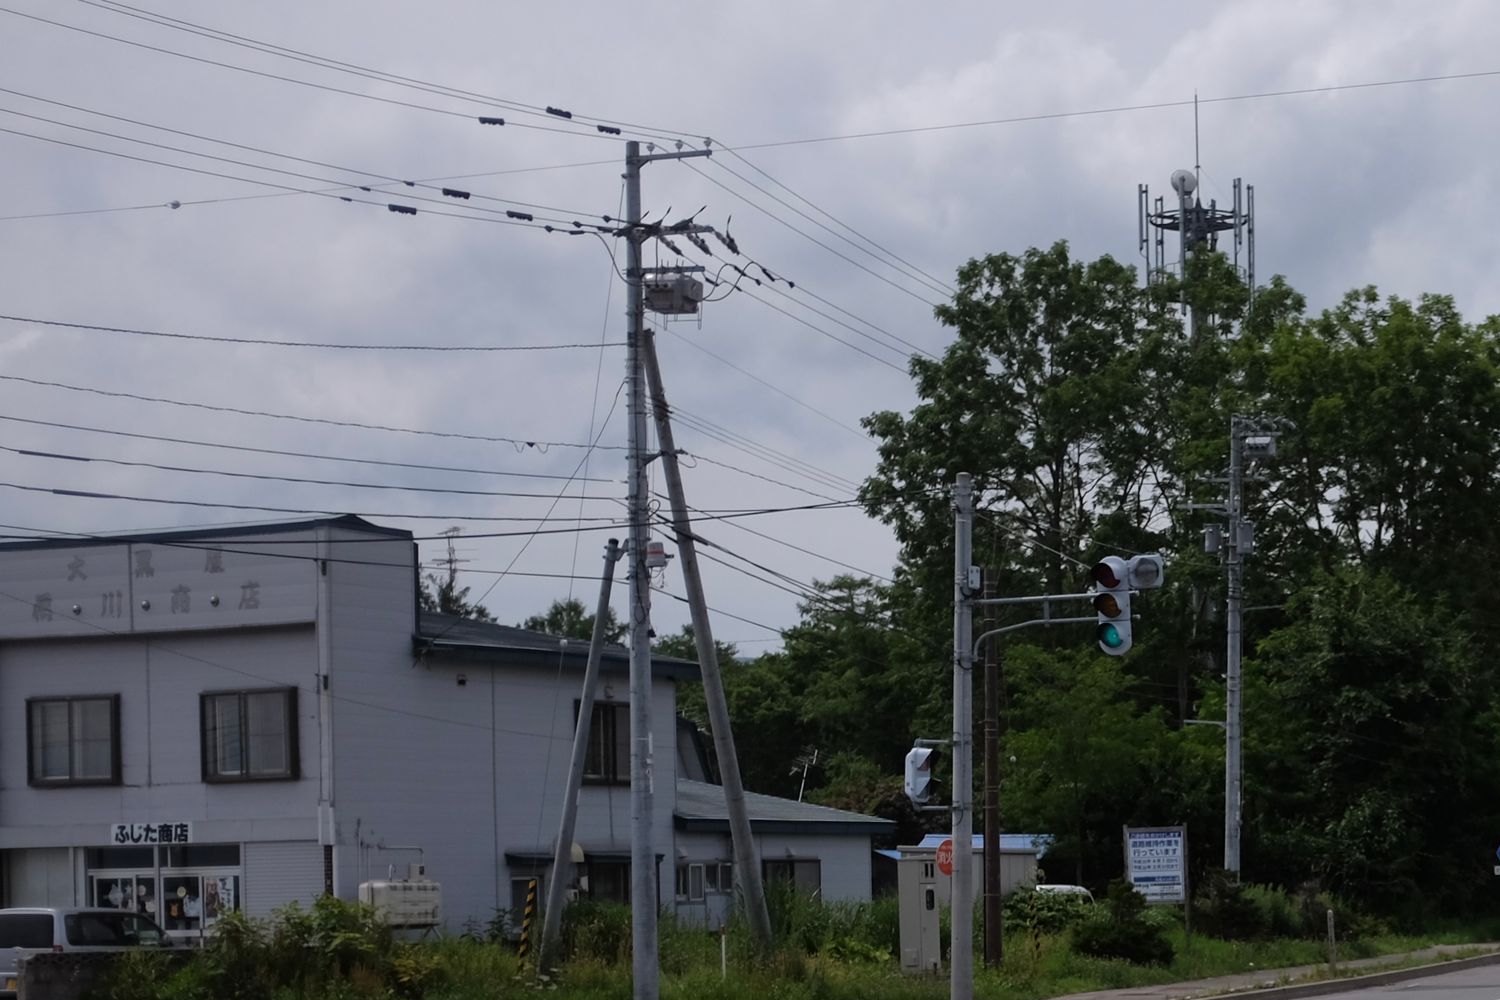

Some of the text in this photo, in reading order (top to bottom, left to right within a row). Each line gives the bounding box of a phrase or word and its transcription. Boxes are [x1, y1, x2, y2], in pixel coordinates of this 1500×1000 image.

[114, 823, 189, 843] ふじた商店
[1133, 848, 1177, 857] 行っています
